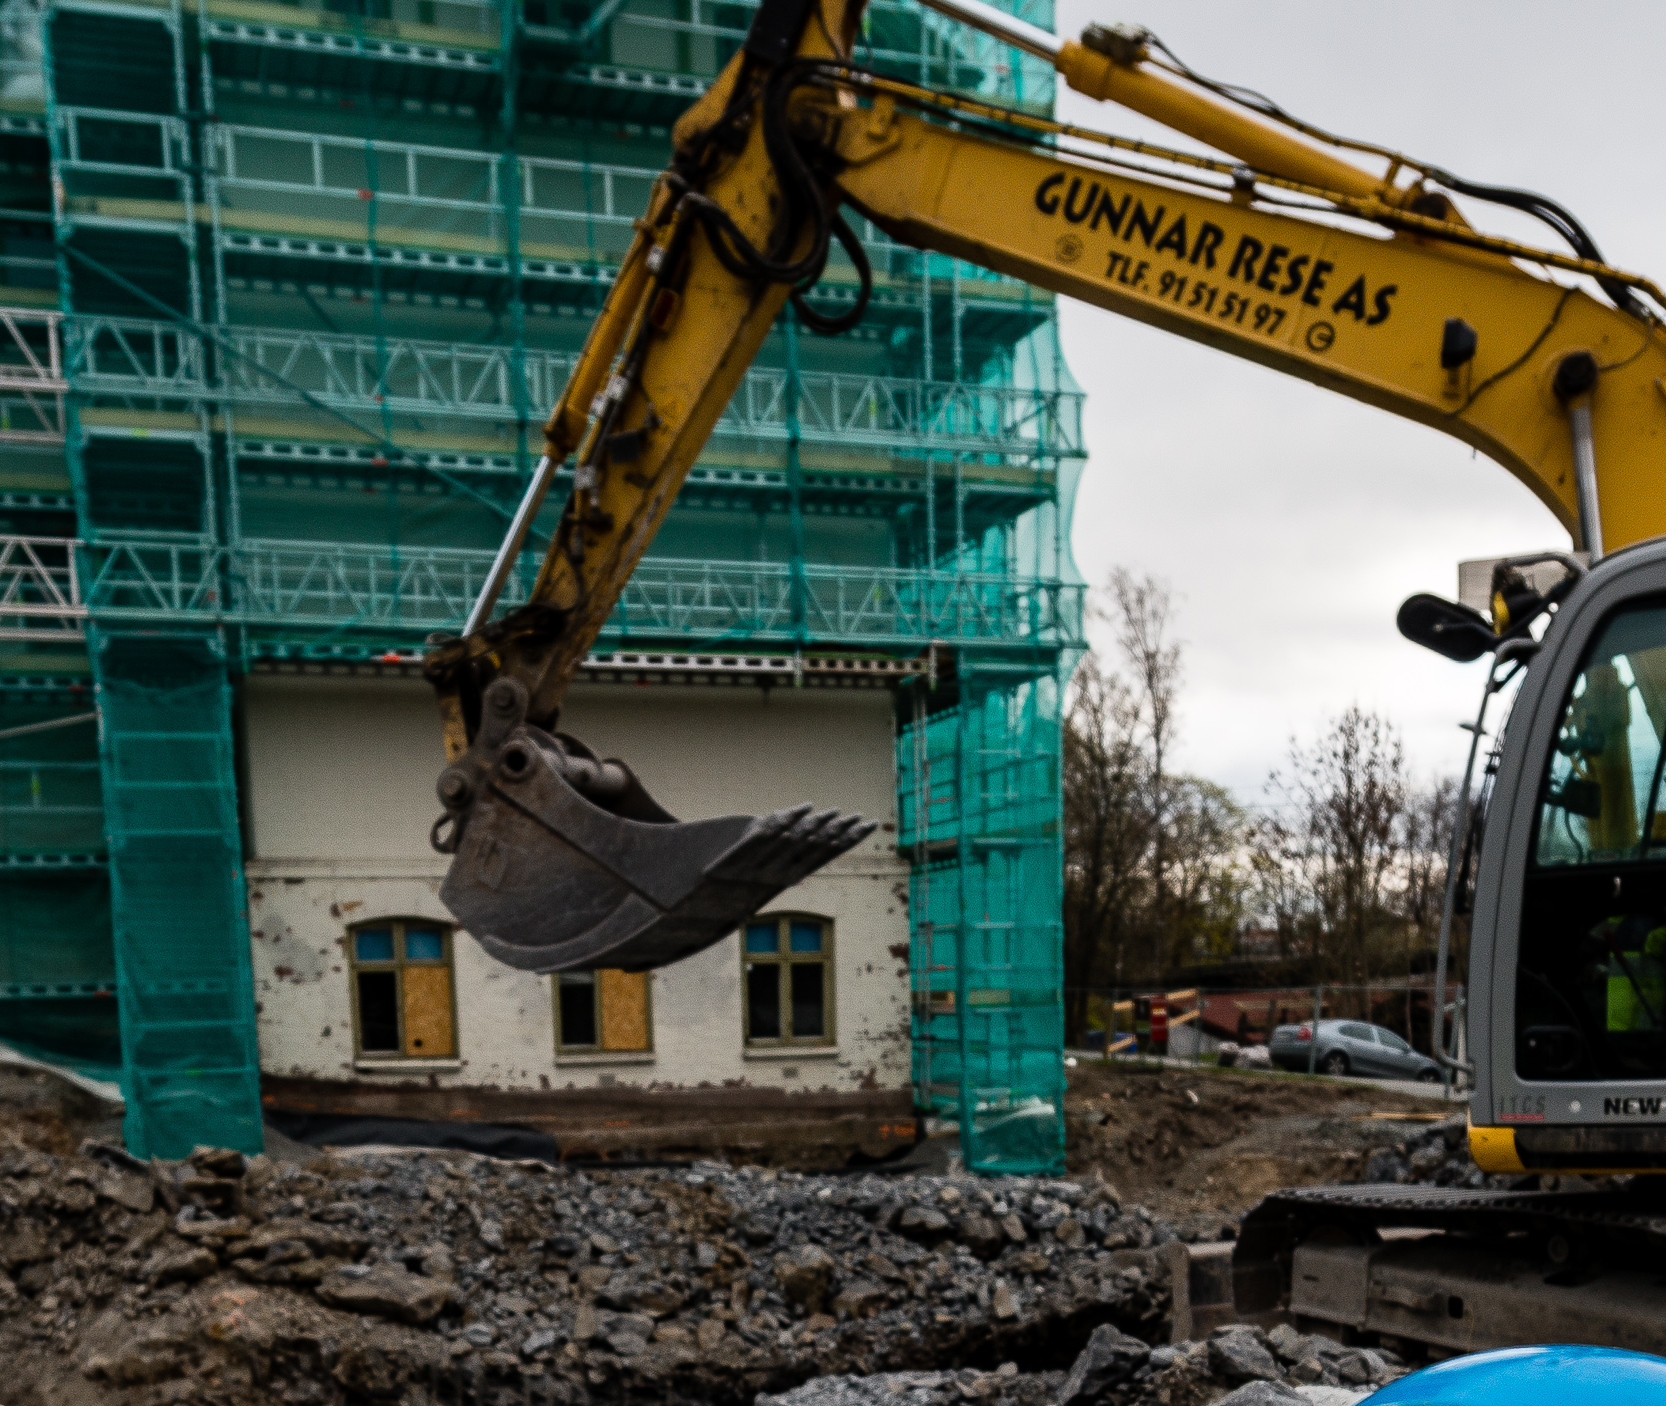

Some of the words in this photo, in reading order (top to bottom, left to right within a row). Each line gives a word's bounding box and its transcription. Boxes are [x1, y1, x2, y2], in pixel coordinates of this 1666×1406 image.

[1034, 172, 1225, 270] GUNNAR
[1230, 235, 1334, 307] RESE
[1332, 273, 1398, 326] AS
[1106, 251, 1149, 292] TLF.
[1603, 1096, 1664, 1116] NEW
